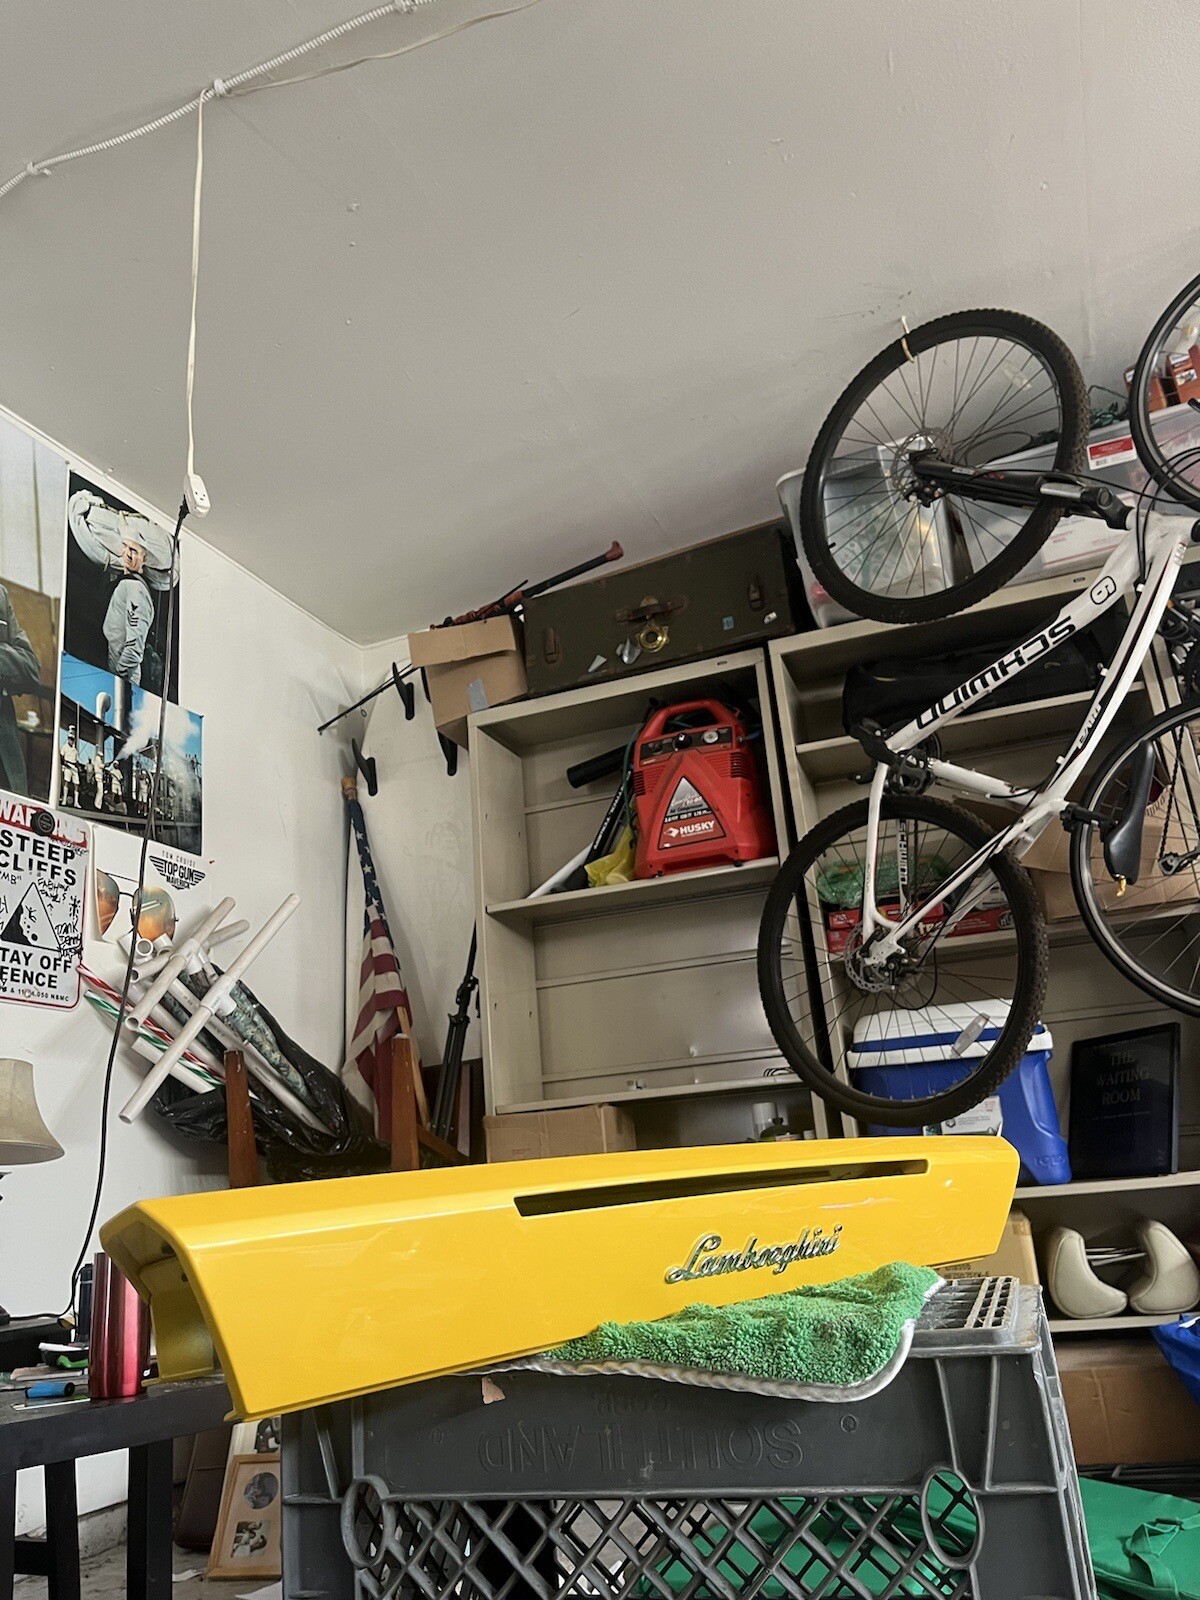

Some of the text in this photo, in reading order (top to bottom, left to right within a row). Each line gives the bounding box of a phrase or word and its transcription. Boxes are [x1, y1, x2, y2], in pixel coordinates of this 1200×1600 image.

[916, 615, 1077, 730] SCHWINN
[679, 820, 715, 835] HUSKY
[0, 829, 76, 865] STEEP
[164, 860, 195, 882] TOP GUN
[40, 955, 72, 974] OFF
[0, 965, 58, 989] FENCE
[1096, 1068, 1150, 1088] WAITING
[1101, 1088, 1141, 1106] ROOM
[664, 1224, 843, 1284] Lamborghini
[477, 1417, 805, 1472] SOUTHLAND
